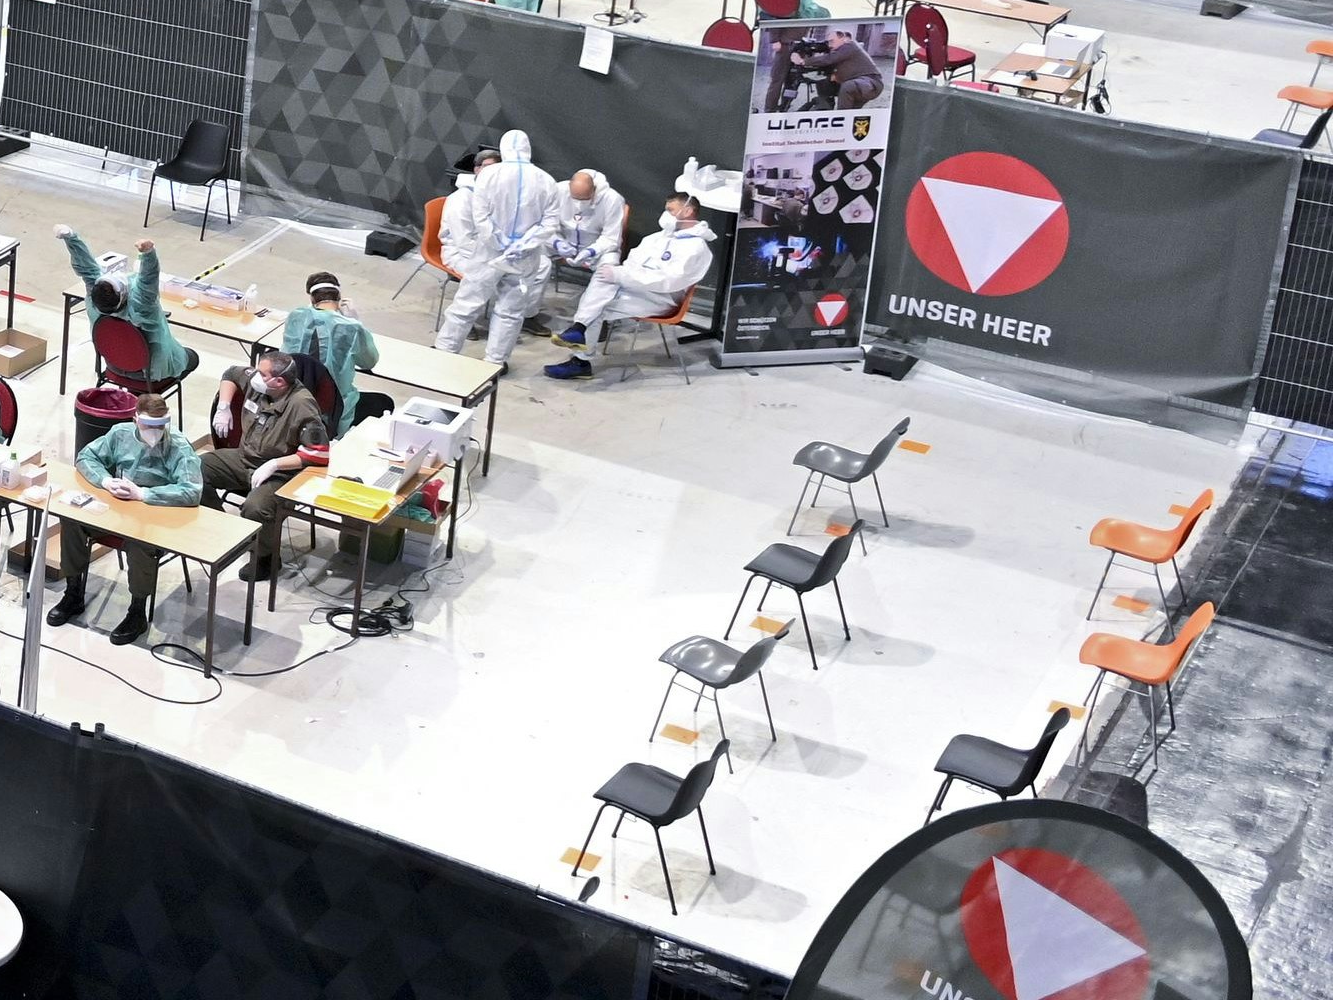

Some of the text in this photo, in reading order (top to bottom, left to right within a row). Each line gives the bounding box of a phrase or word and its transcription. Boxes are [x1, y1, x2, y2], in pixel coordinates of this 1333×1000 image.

[888, 294, 1052, 346] UNSER HEER
[920, 969, 975, 1000] UN
